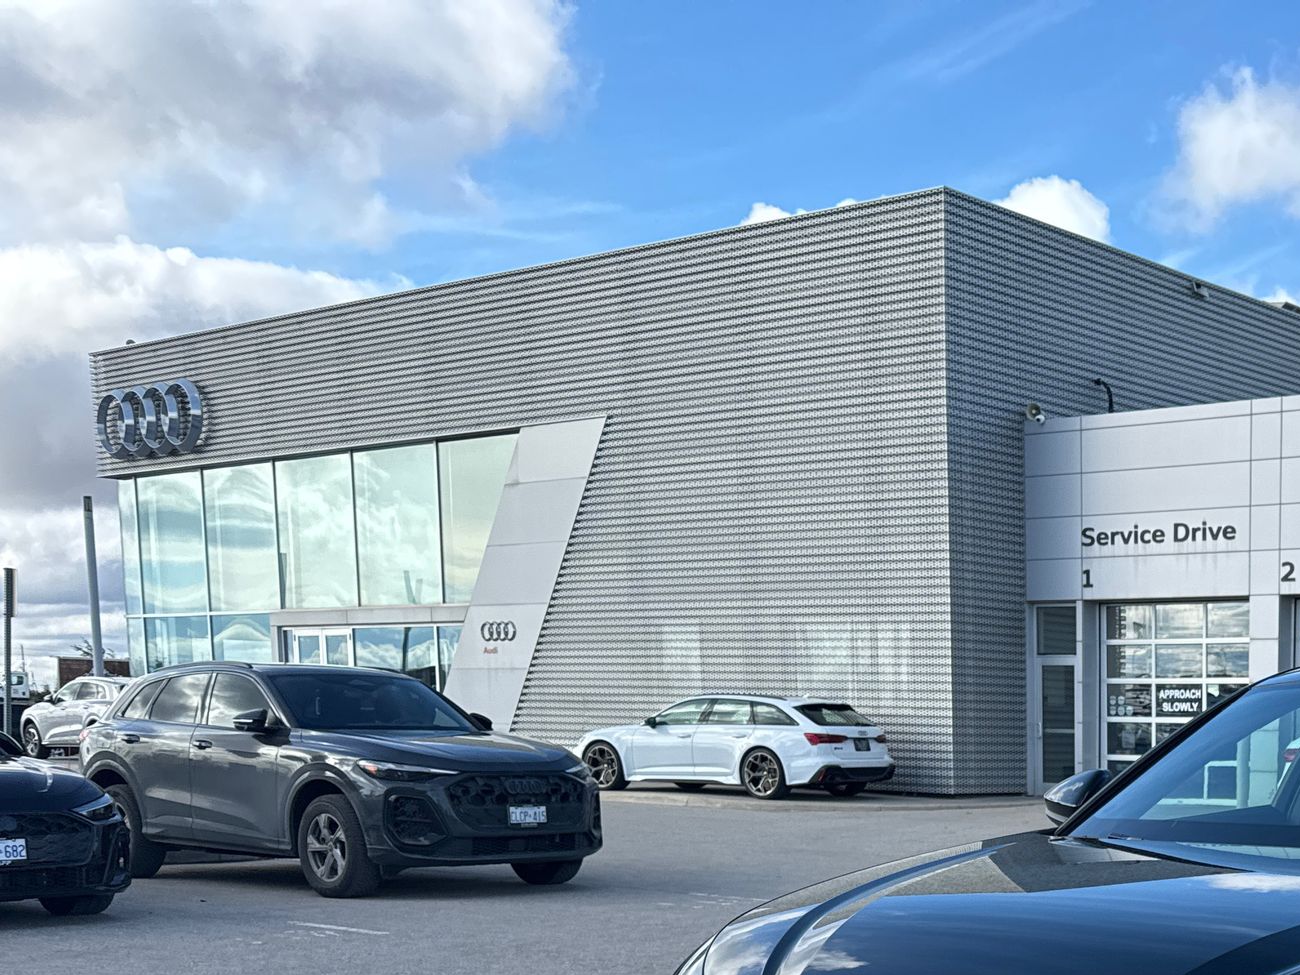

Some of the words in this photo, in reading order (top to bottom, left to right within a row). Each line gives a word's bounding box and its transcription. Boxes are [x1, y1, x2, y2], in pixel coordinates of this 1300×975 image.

[1081, 524, 1165, 547] Service
[1173, 521, 1237, 543] Drive
[1082, 569, 1093, 588] 1
[1280, 562, 1296, 582] 2
[1159, 689, 1201, 699] APPROACH
[1162, 702, 1198, 712] SLOWLY
[4, 844, 26, 858] 682
